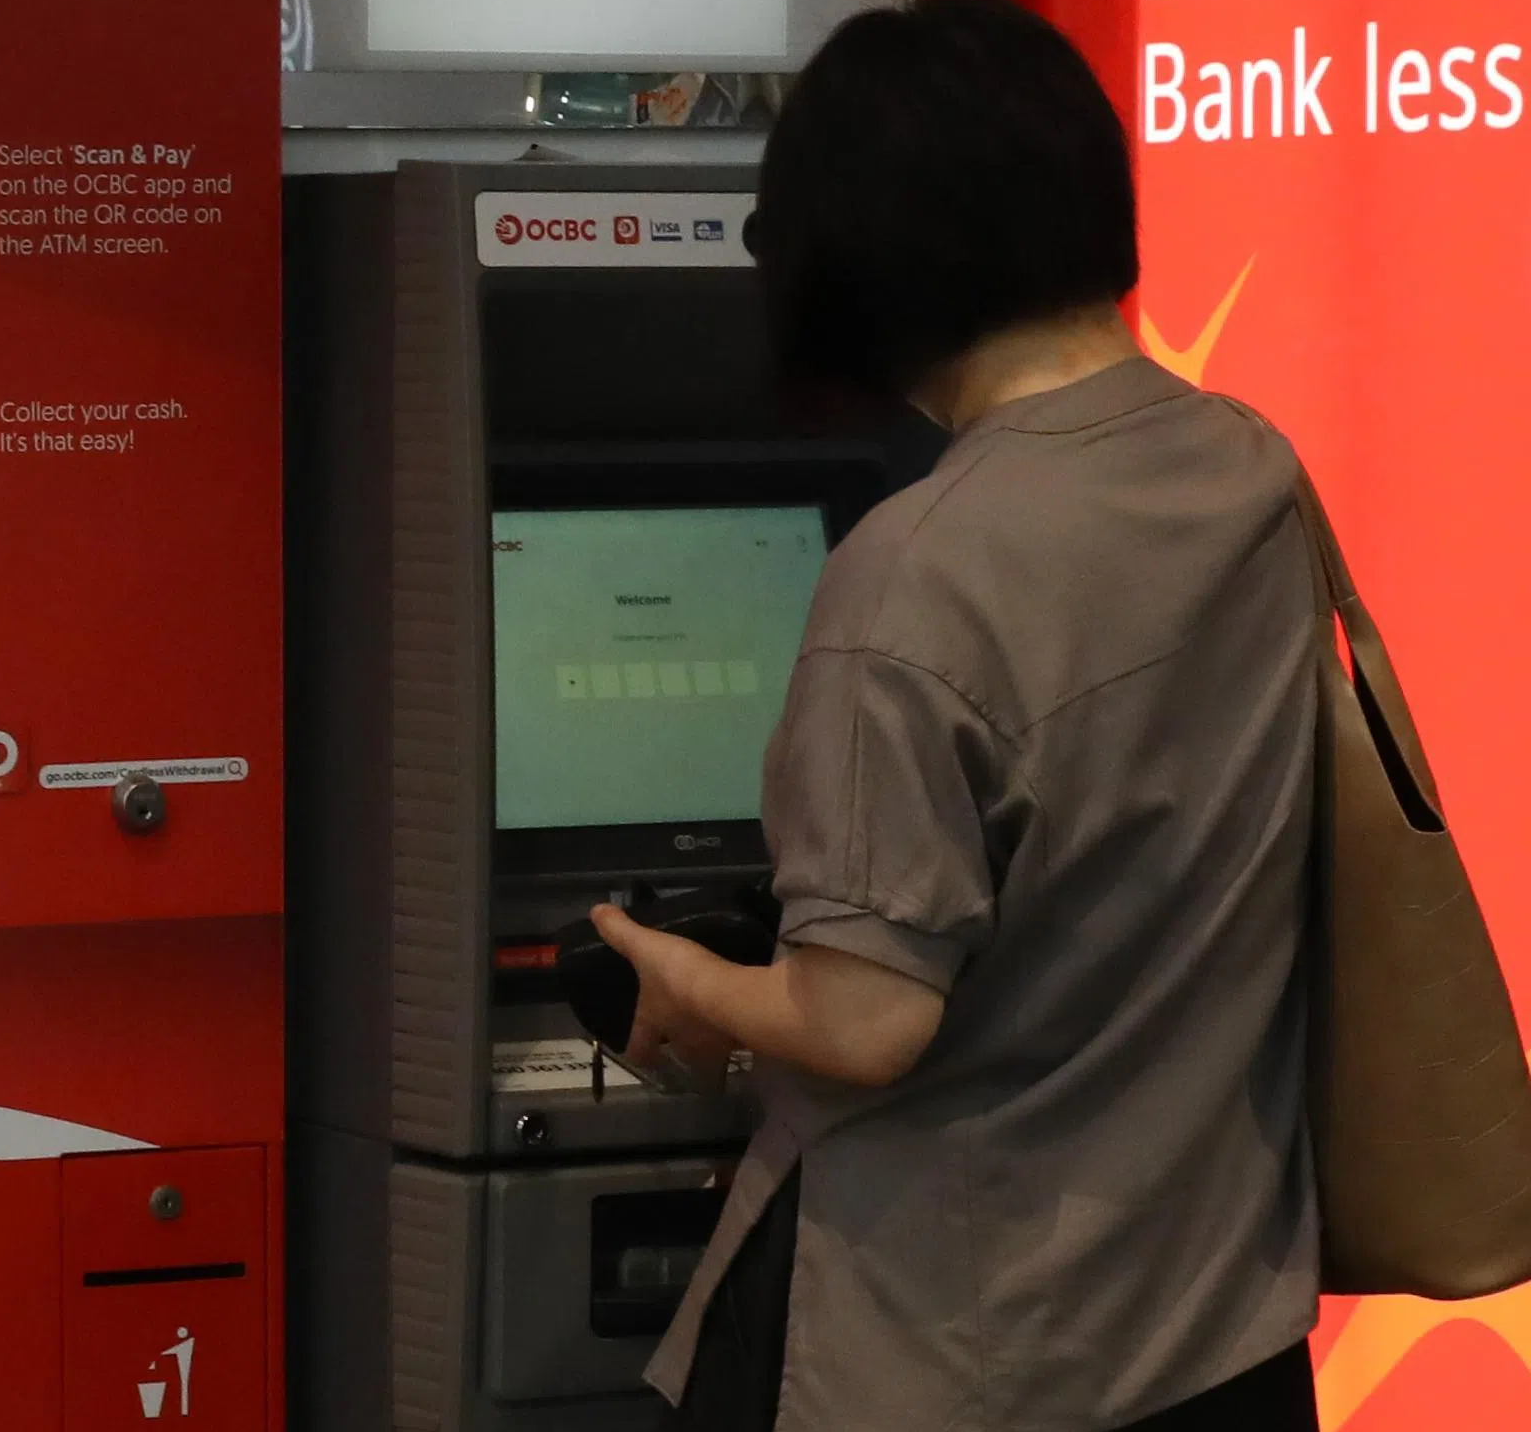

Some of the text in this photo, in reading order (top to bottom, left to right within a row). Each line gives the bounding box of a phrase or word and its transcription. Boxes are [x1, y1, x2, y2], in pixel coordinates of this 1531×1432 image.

[1144, 22, 1524, 143] Bank less
[130, 146, 148, 166] &
[32, 174, 68, 195] the
[73, 174, 138, 195] OCBC
[143, 178, 187, 199] app
[192, 174, 232, 194] and
[52, 204, 88, 225] the
[93, 204, 127, 226] QR
[132, 203, 188, 224] code
[193, 207, 222, 224] on
[526, 218, 598, 242] OCBC
[653, 222, 681, 234] VISA
[39, 234, 88, 255] ATM
[93, 237, 169, 255] screen.
[0, 399, 188, 426] Collect your cash.
[0, 430, 134, 453] It's that easy!
[615, 594, 672, 606] Welcome
